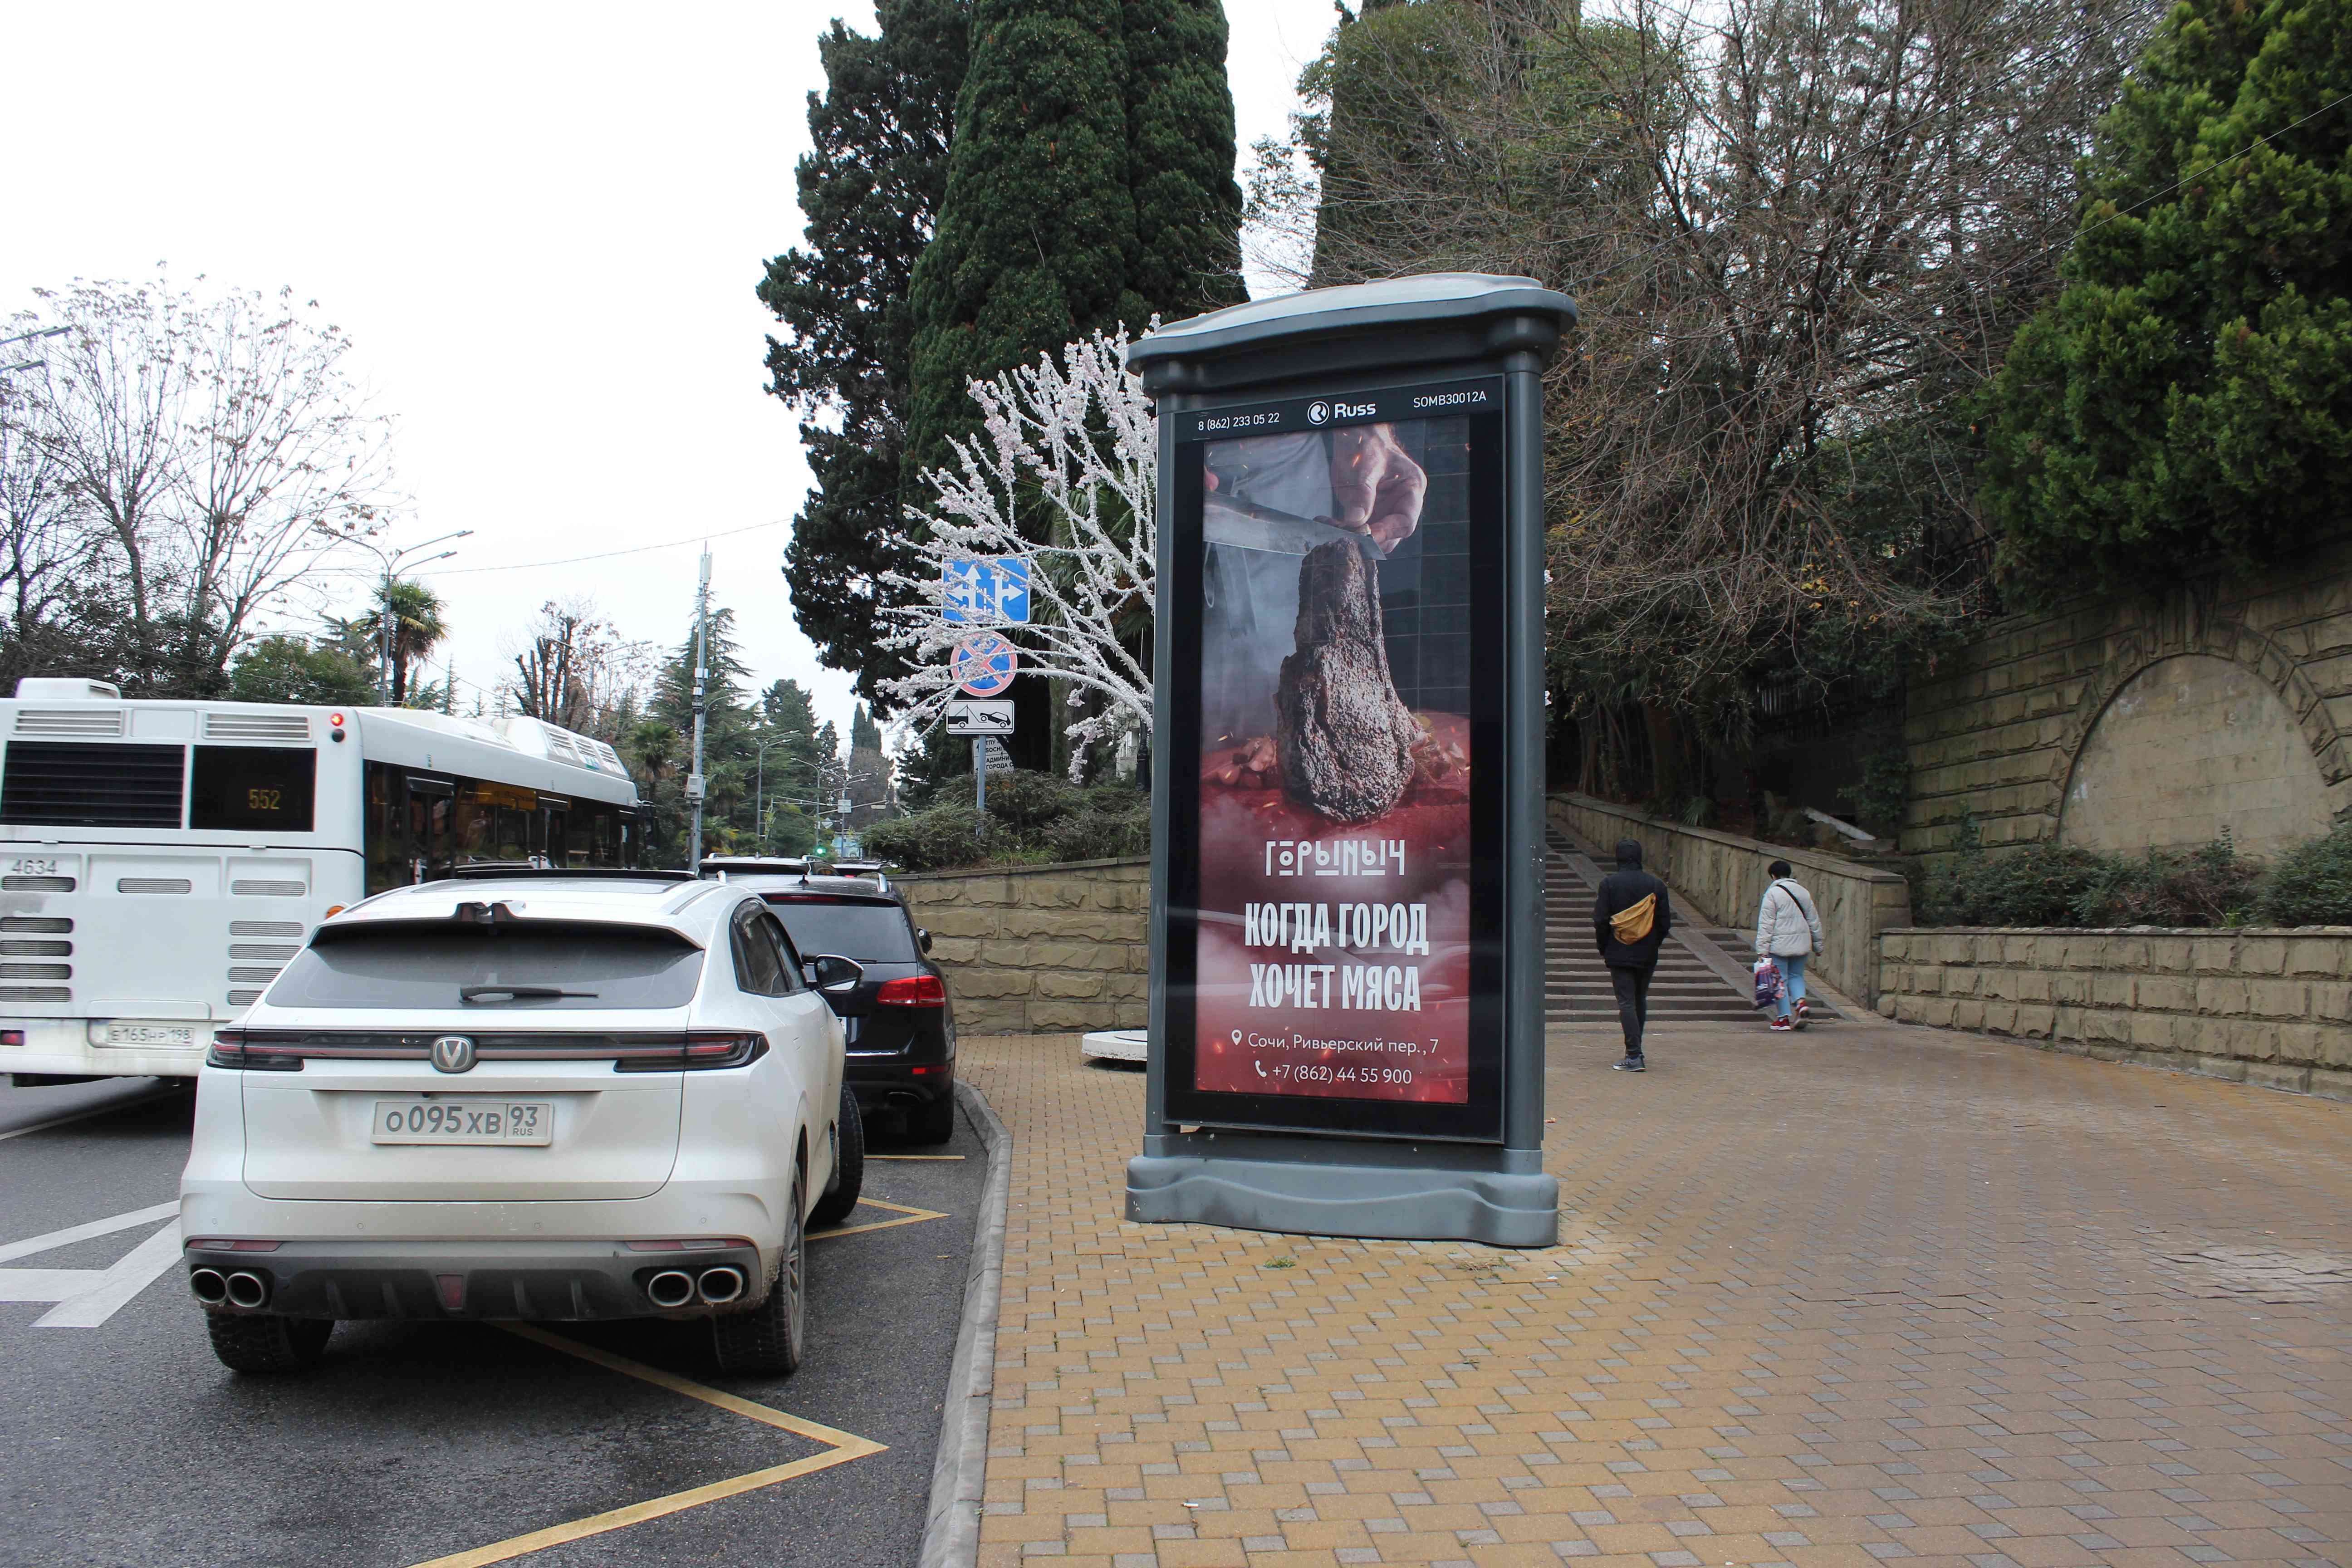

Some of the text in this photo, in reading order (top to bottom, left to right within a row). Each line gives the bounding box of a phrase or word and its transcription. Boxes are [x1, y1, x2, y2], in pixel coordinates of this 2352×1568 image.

[1413, 391, 1487, 408] SOMB30012A
[1334, 402, 1377, 419] Russ
[1198, 412, 1280, 431] 8 (862) 233 05 22
[249, 789, 280, 809] 552
[11, 860, 57, 875] 4634
[1245, 902, 1430, 956] КОГДА ГОРОД
[1249, 963, 1421, 1011] ХОЧЕТ МЯСА
[1248, 1033, 1289, 1050] Сочи,
[1293, 1034, 1384, 1052] Ривьерский
[1430, 1039, 1439, 1053] 7
[1273, 1064, 1412, 1084] +7 (862) 44 55 900
[510, 1106, 538, 1127] 93
[513, 1127, 534, 1136] RUS
